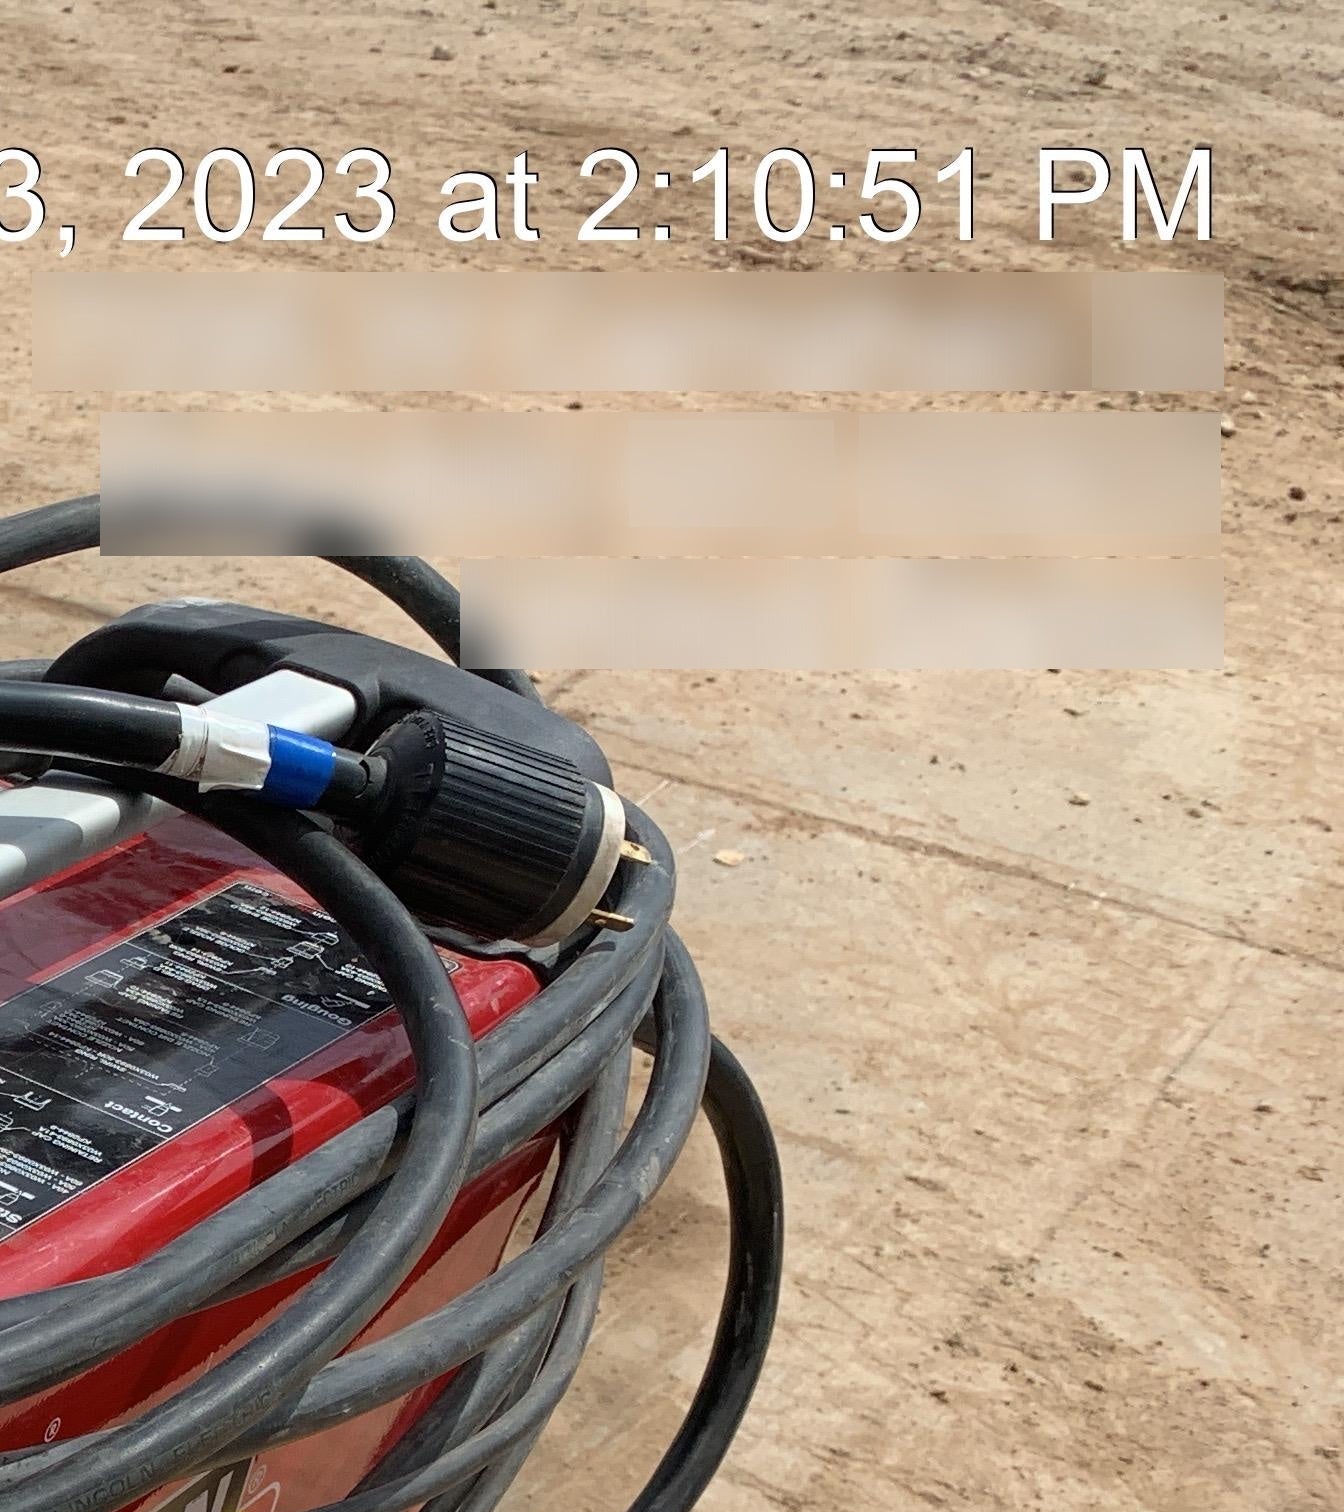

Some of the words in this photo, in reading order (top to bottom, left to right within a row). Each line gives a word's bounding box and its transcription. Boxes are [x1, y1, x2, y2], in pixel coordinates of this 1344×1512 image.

[281, 994, 351, 1026] Gouging
[104, 1100, 172, 1132] Contact
[30, 1130, 52, 1141] CAP
[52, 1139, 102, 1163] RETAINING
